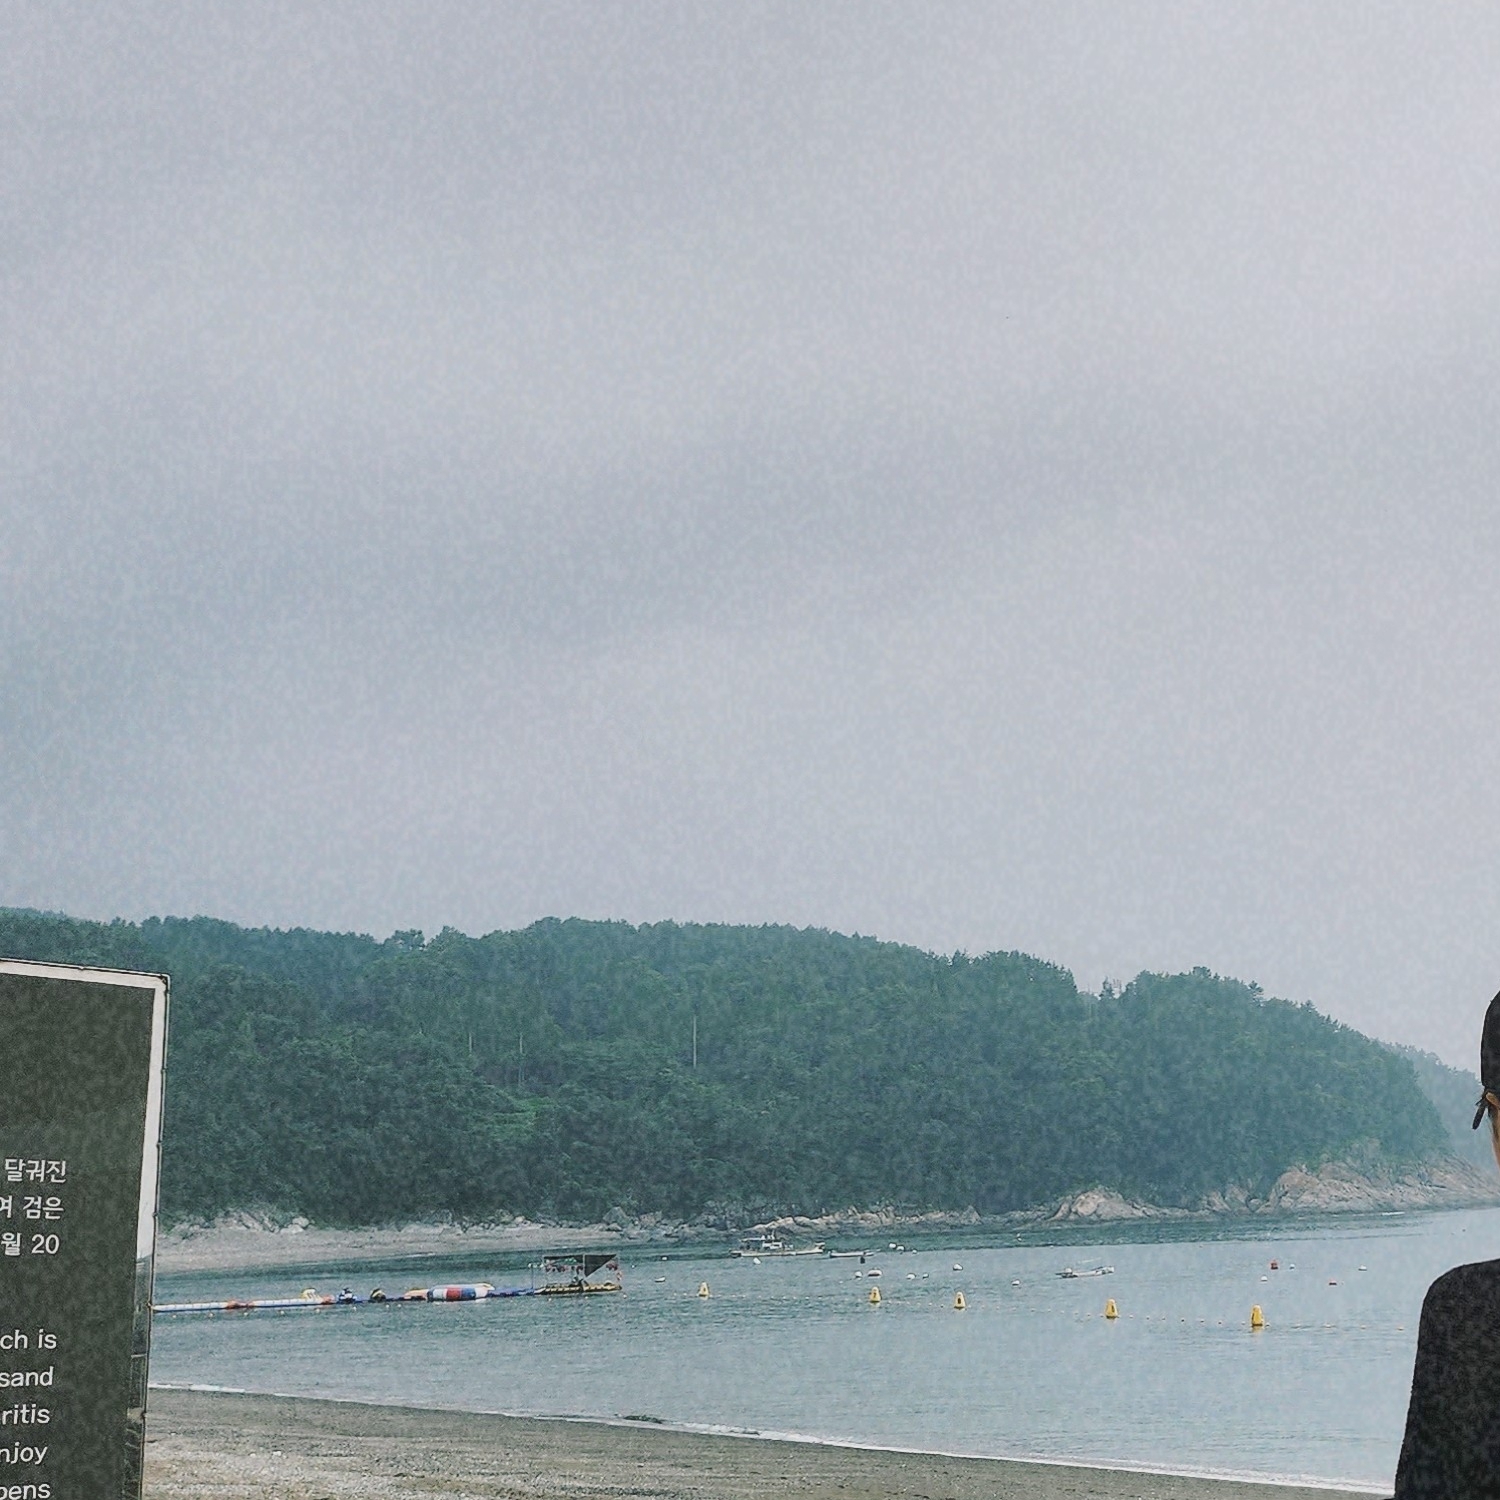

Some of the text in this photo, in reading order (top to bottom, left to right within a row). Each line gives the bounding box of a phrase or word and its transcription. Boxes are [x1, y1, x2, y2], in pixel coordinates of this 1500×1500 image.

[4, 1158, 67, 1184] 달궈진
[22, 1196, 65, 1220] 검은
[0, 1232, 60, 1257] 월 20
[0, 1328, 57, 1350] ch is
[0, 1366, 54, 1388] sand
[2, 1403, 50, 1425] ritis
